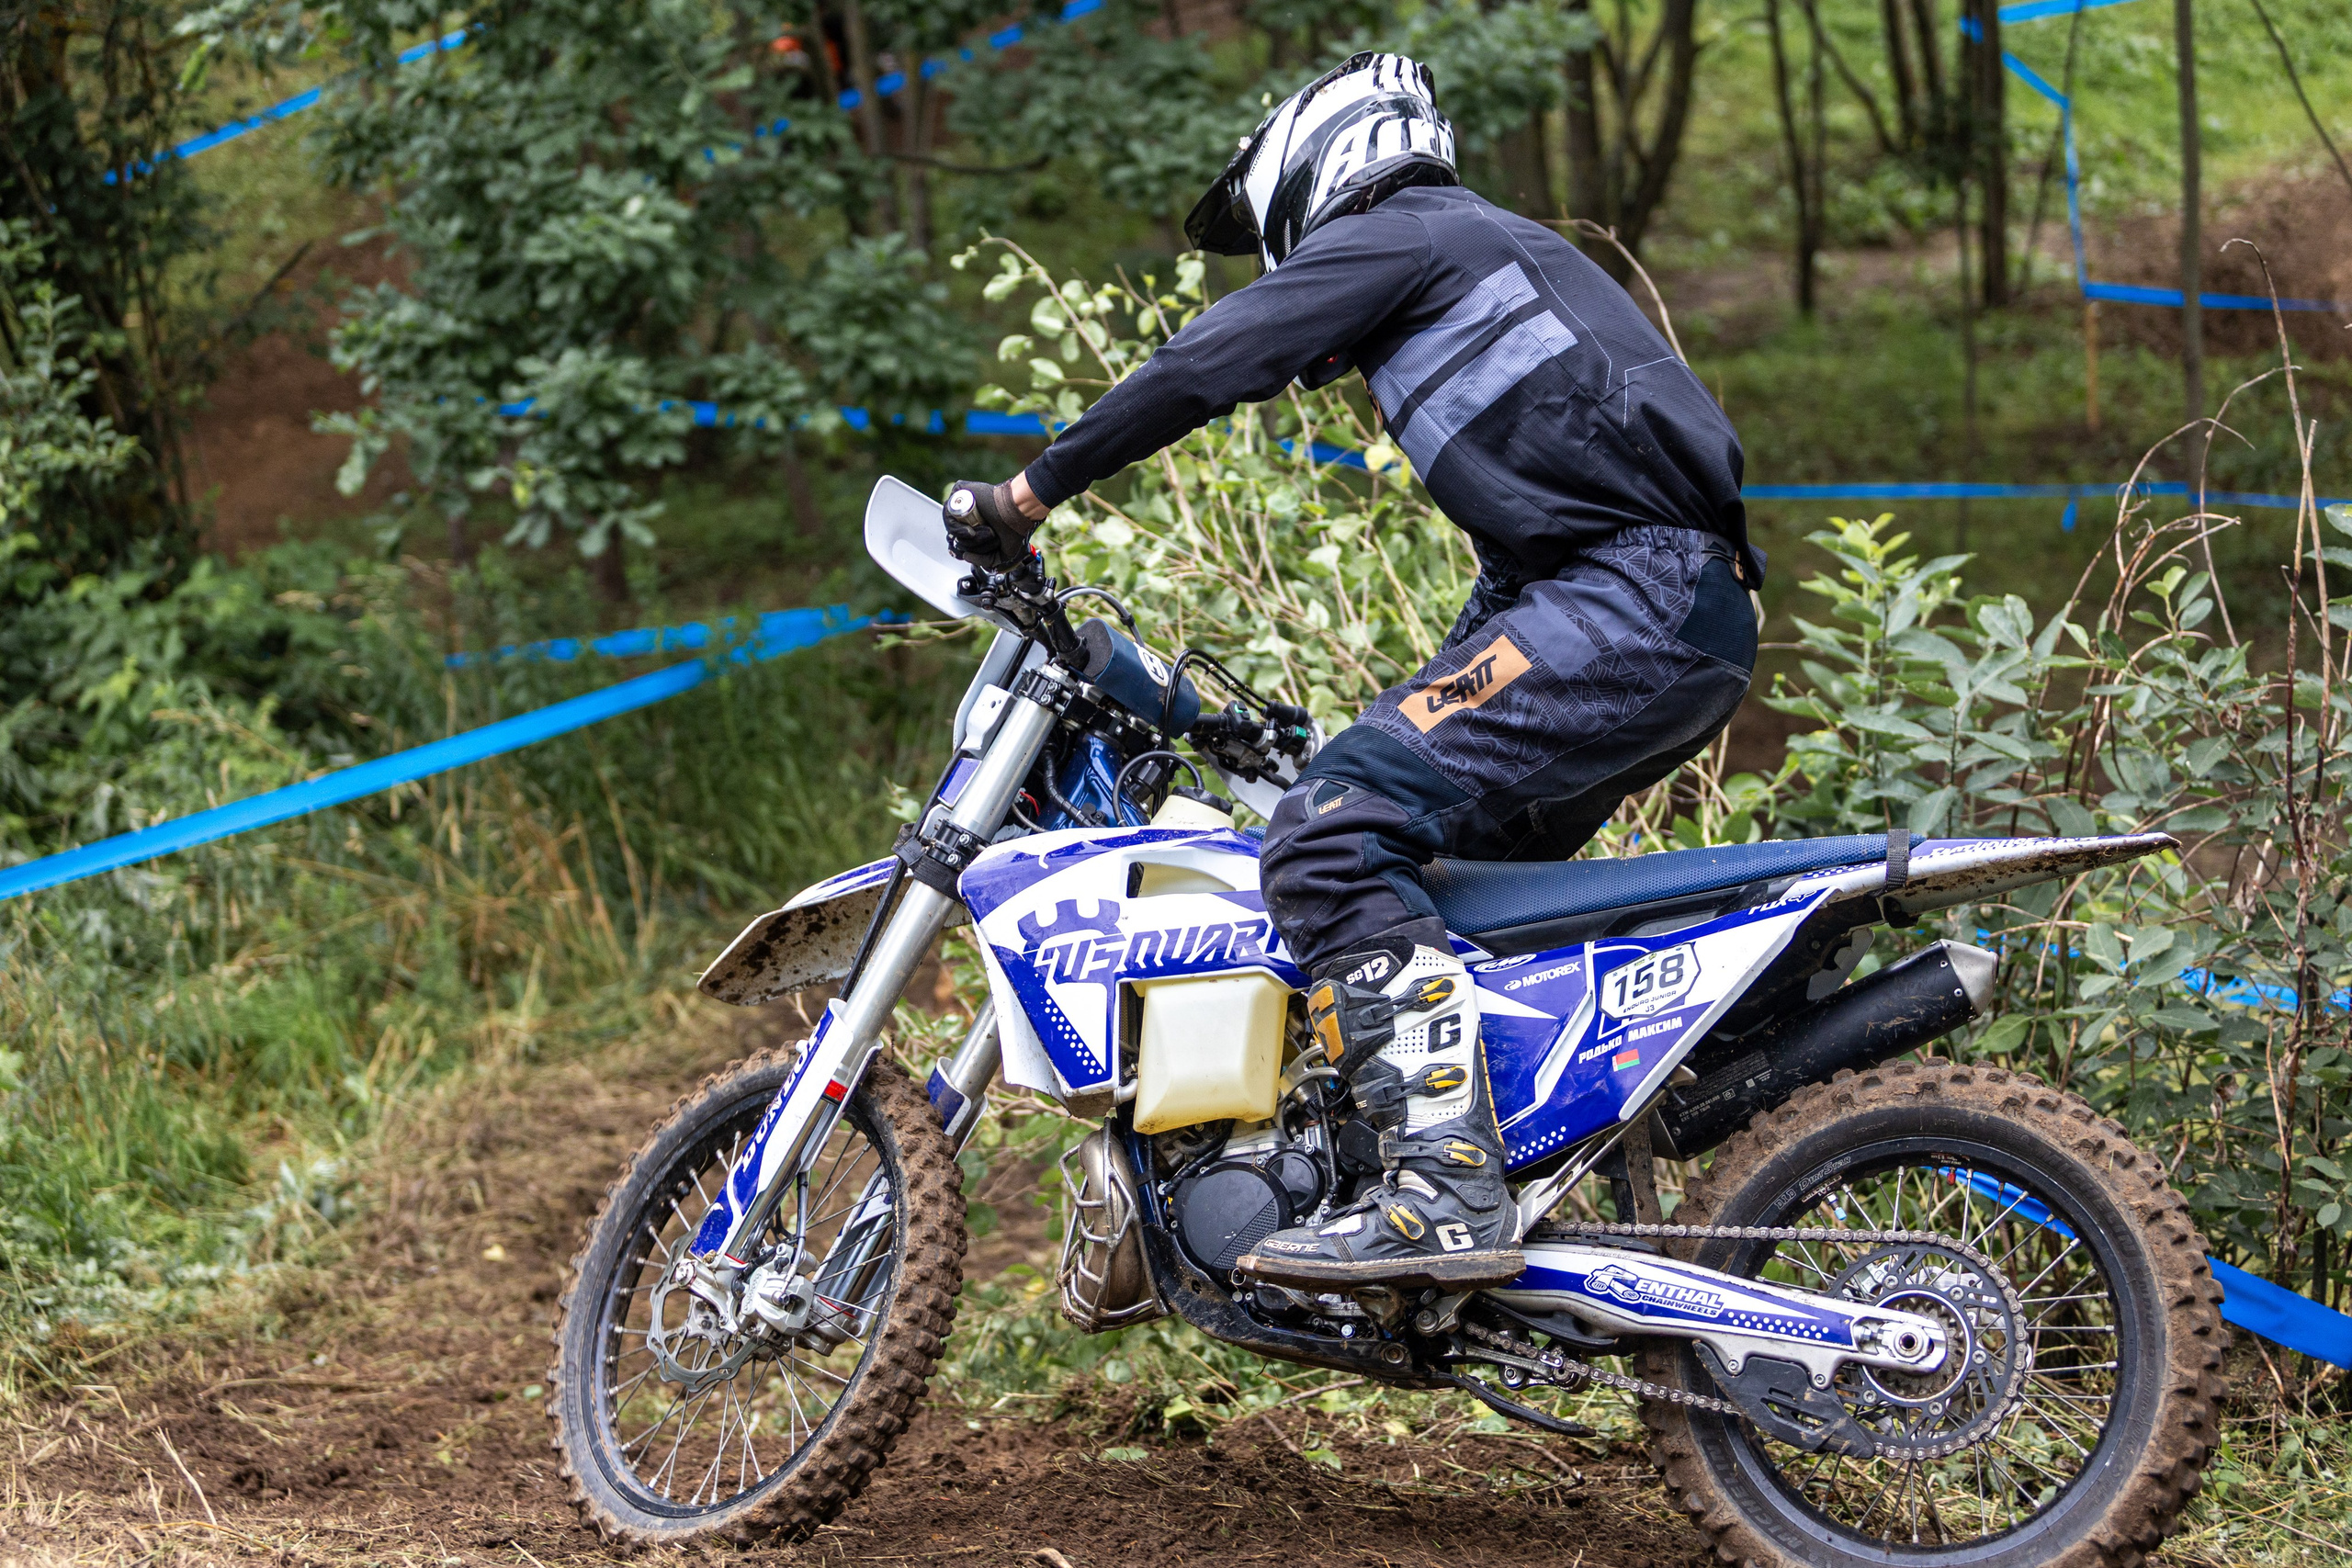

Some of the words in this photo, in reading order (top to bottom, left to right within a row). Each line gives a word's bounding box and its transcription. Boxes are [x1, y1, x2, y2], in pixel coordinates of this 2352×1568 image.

[1250, 137, 1270, 176] THUNDER
[1426, 653, 1497, 714] LEATT
[1317, 795, 1344, 815] LEATT
[1521, 962, 1581, 987] MOTOREX
[1614, 953, 1685, 1008] 158
[1623, 998, 1650, 1013] ENDURO
[1650, 990, 1677, 1004] JUNIOR
[1645, 1004, 1656, 1013] J3
[1578, 1034, 1623, 1064] РОДЬКО
[1627, 1016, 1683, 1043] МАКСИМ
[1584, 1264, 1724, 1308] RENTHAL
[1641, 1294, 1718, 1316] CHAINWHEELS
